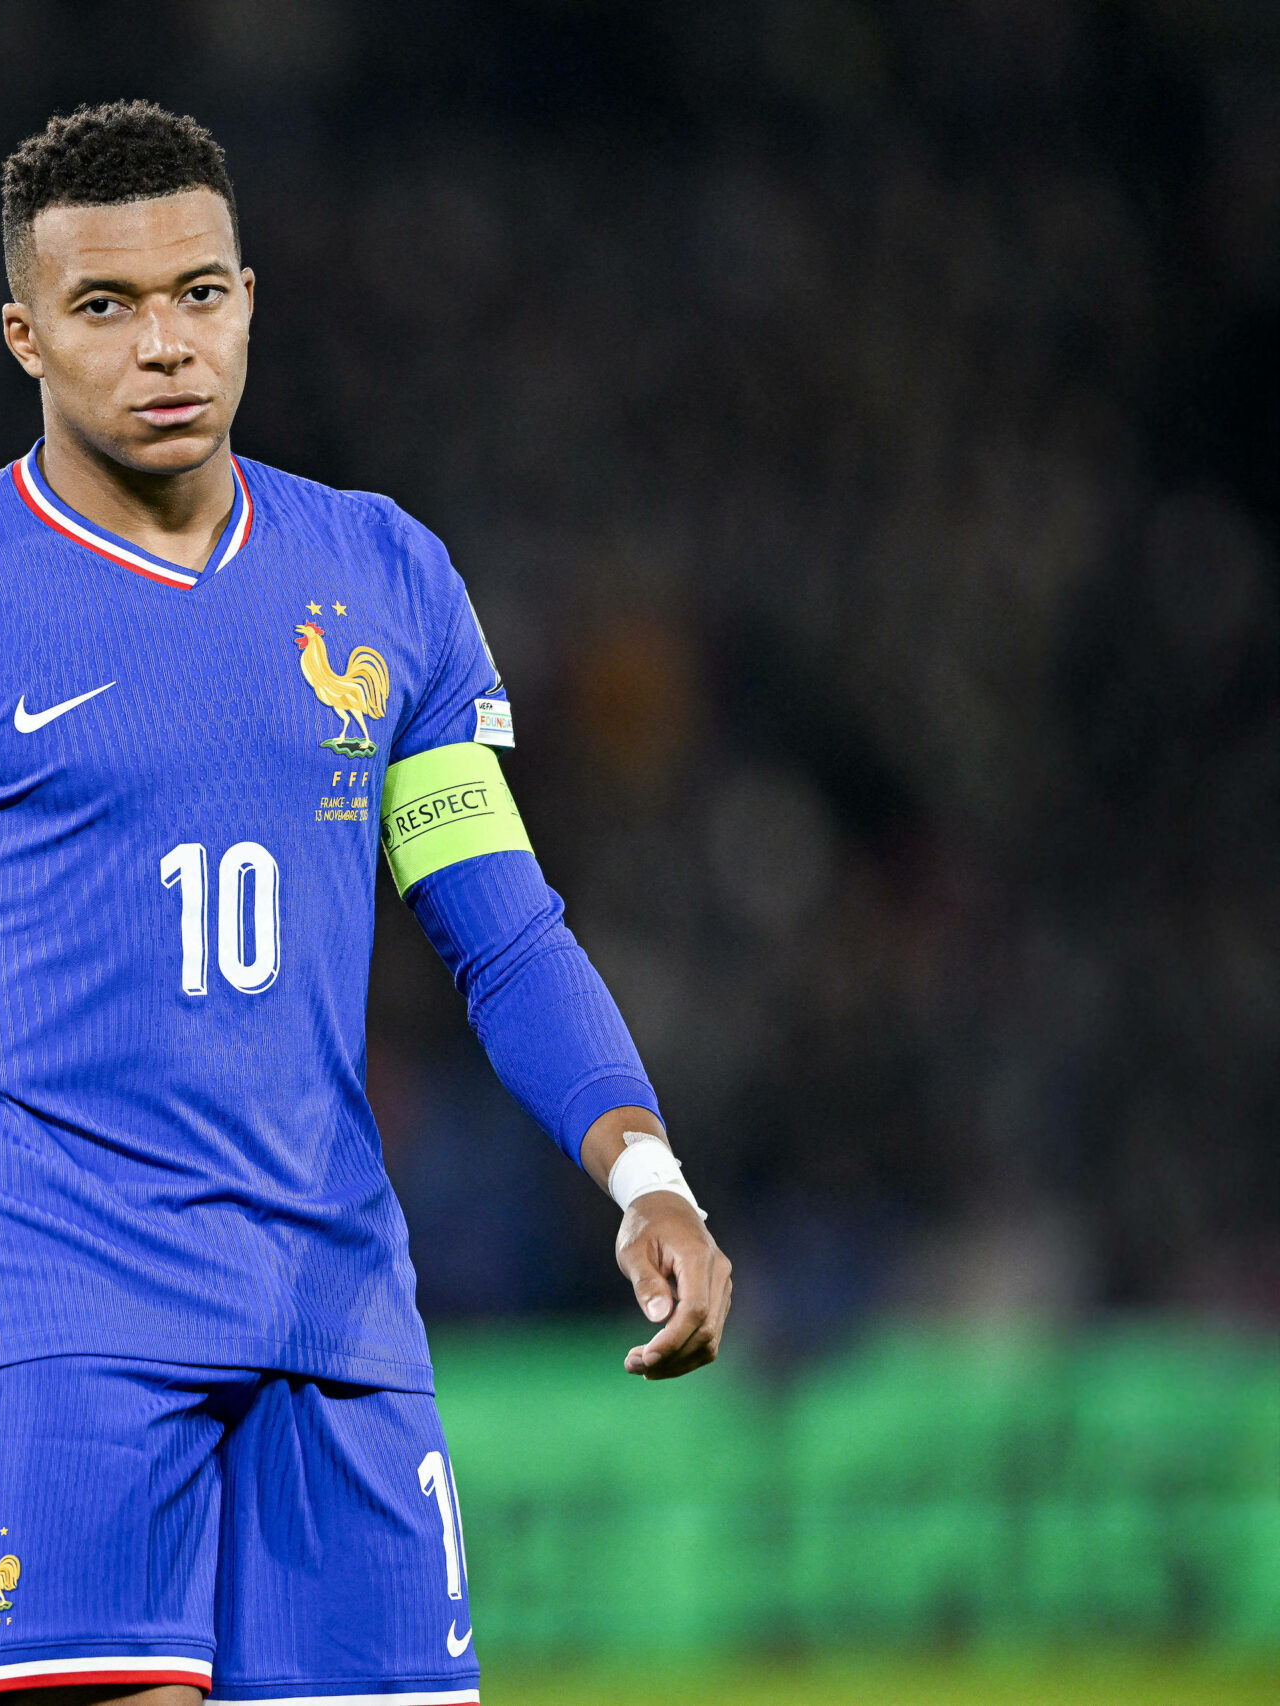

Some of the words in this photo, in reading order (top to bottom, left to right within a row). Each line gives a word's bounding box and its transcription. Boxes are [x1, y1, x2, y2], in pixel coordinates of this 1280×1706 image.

[480, 715, 512, 728] FOUNDA
[315, 810, 322, 821] 13
[323, 810, 359, 821] NOVEMBRE
[320, 797, 345, 808] FRANCE
[395, 789, 488, 836] RESPECT
[160, 841, 281, 996] 10
[417, 1451, 468, 1600] 1
